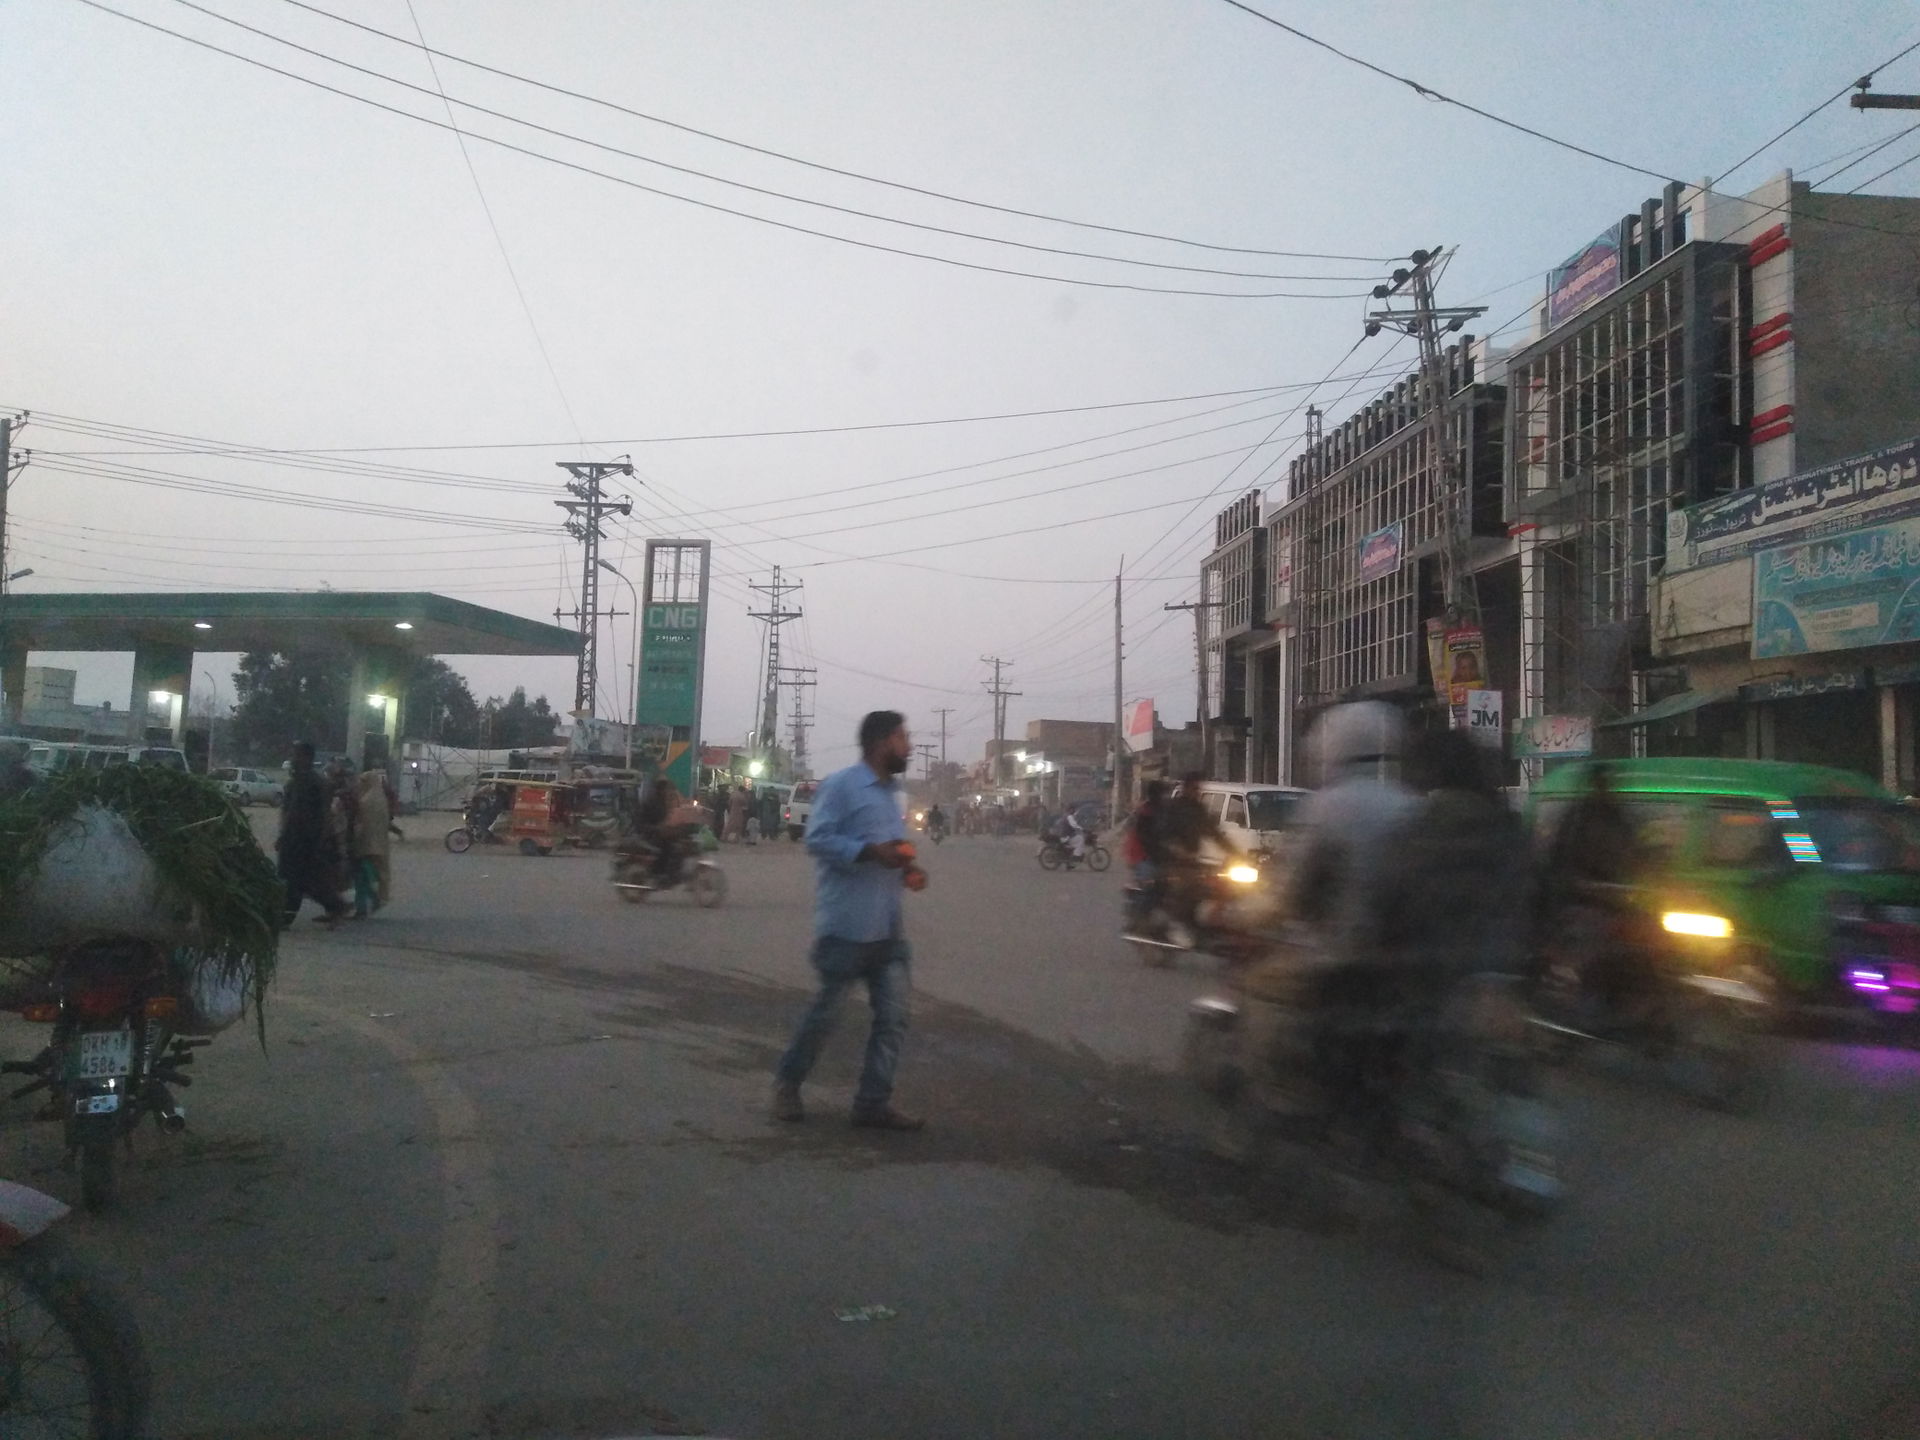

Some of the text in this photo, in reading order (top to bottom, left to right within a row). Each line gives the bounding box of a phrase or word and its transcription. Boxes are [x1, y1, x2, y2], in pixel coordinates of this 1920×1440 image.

[1784, 463, 1842, 486] INTERNATIONAL
[1845, 453, 1875, 467] TRAVEL
[1886, 440, 1915, 454] TOURS
[648, 607, 697, 629] CNG
[1471, 709, 1499, 728] JM
